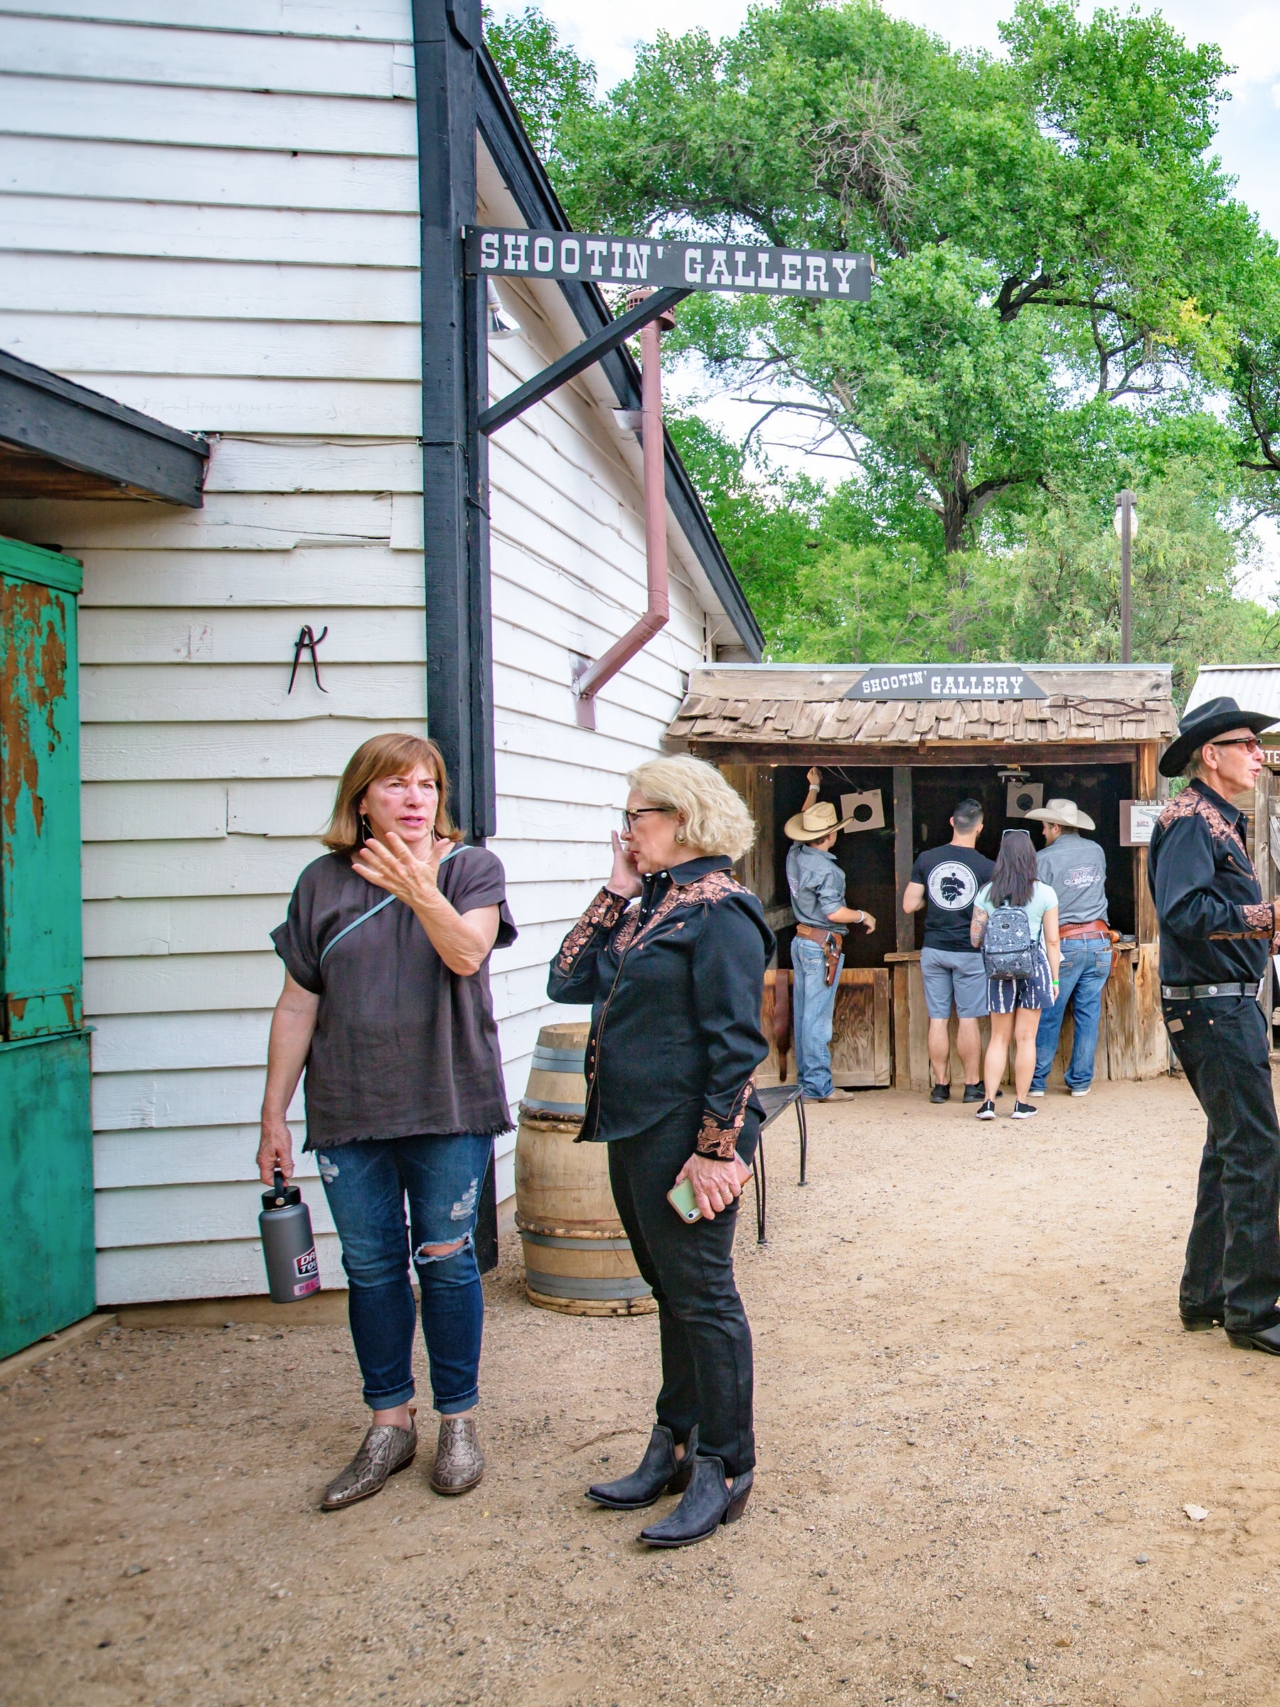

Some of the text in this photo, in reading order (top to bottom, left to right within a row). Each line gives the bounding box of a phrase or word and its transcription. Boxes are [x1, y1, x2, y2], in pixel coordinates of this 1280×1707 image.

[480, 233, 857, 294] SHOOTIN' GALLERY
[862, 671, 1024, 694] SHOOTIN' GALLERY
